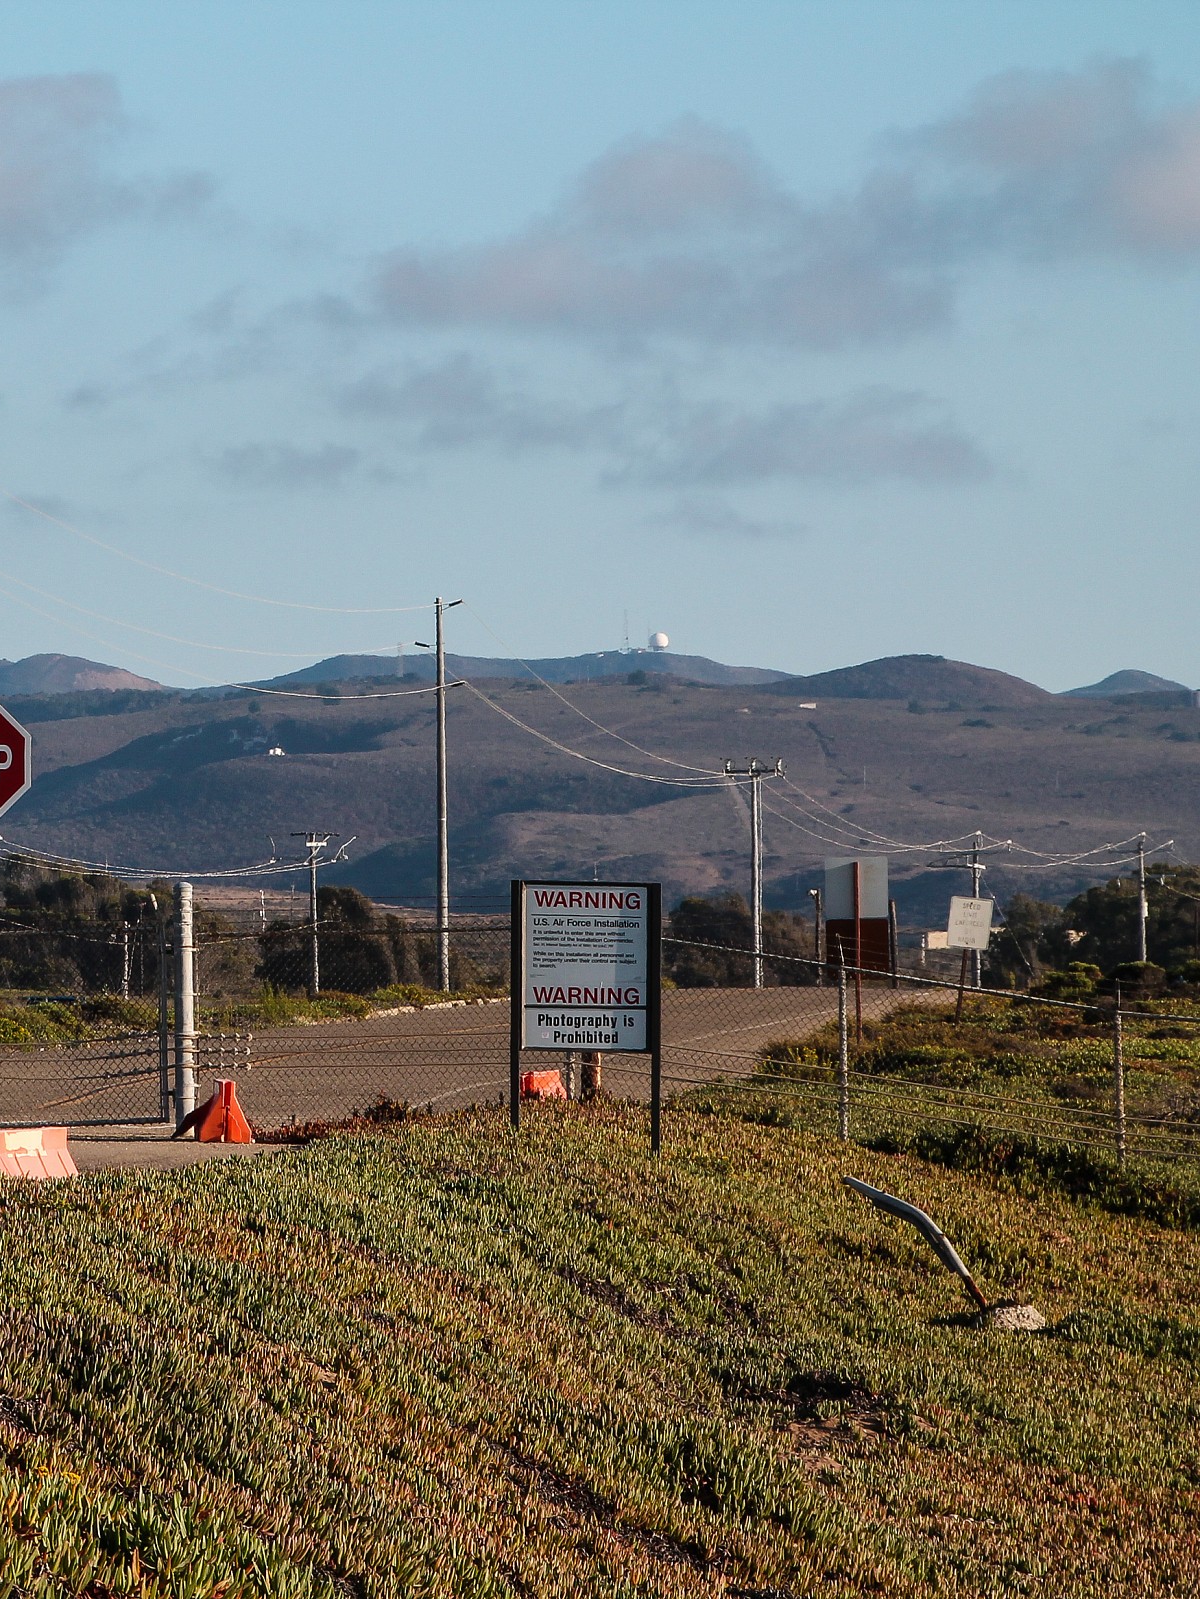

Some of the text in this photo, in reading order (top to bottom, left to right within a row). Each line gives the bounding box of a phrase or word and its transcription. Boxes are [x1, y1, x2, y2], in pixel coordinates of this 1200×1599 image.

[534, 890, 641, 910] WARNING
[533, 918, 640, 928] U.S. Air Force Installation
[533, 986, 640, 1005] WARNING
[538, 1014, 634, 1029] Photography is
[554, 1031, 618, 1044] Prohibited
